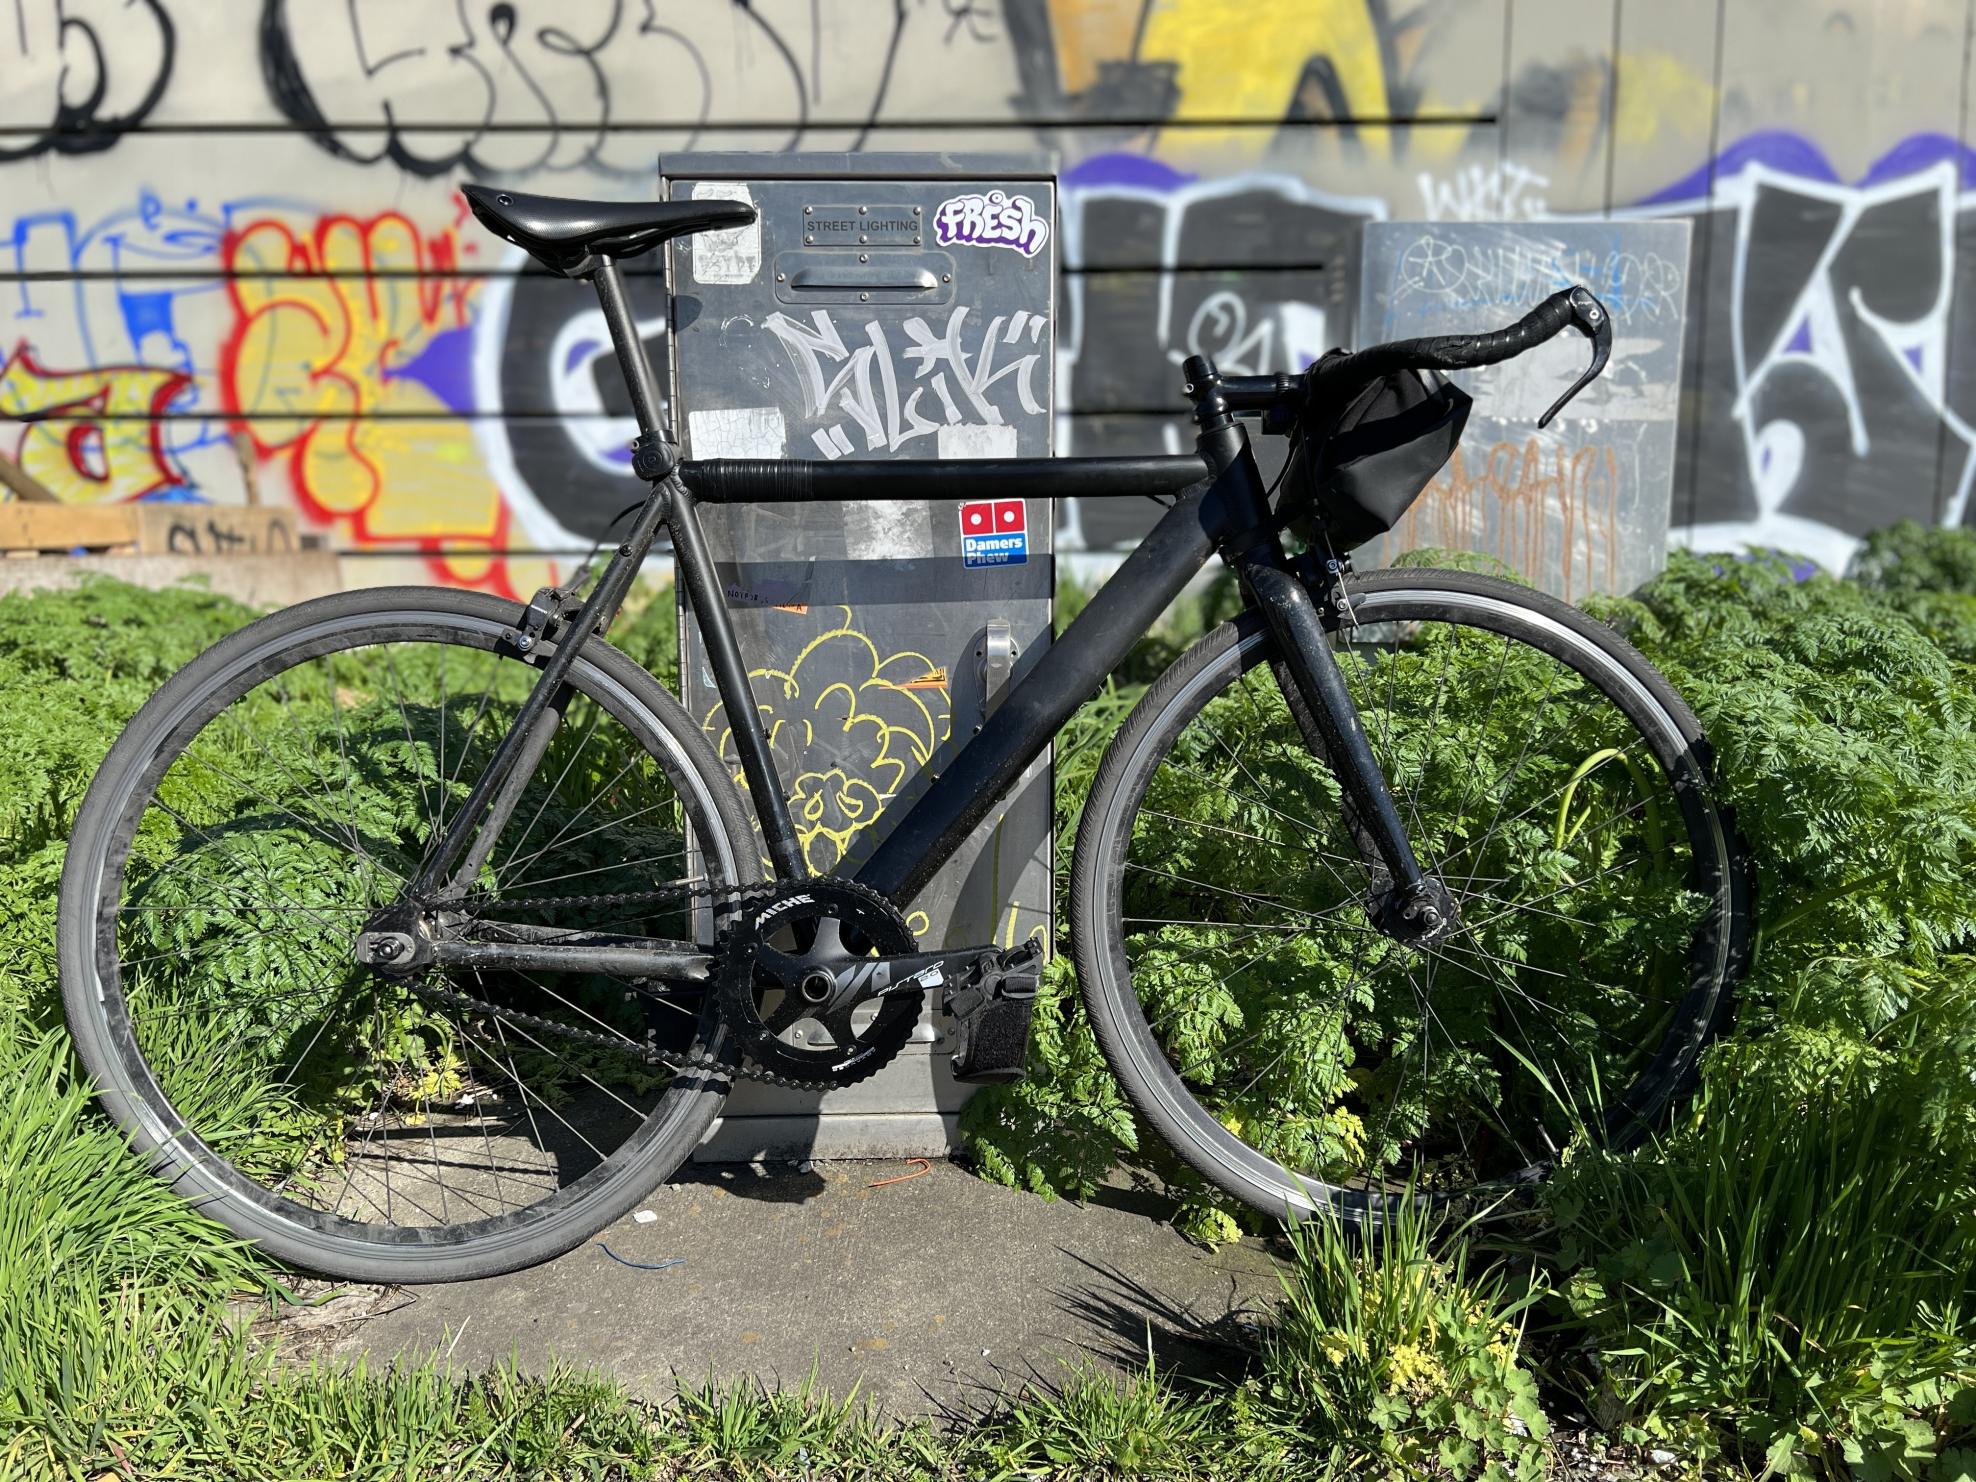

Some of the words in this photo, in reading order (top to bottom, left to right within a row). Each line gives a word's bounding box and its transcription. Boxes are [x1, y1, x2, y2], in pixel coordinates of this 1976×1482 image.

[808, 221, 855, 231] STREET
[860, 221, 918, 231] LIGHTING
[965, 538, 1023, 552] Damers
[966, 552, 1009, 565] Phew
[755, 894, 815, 931] MICHE
